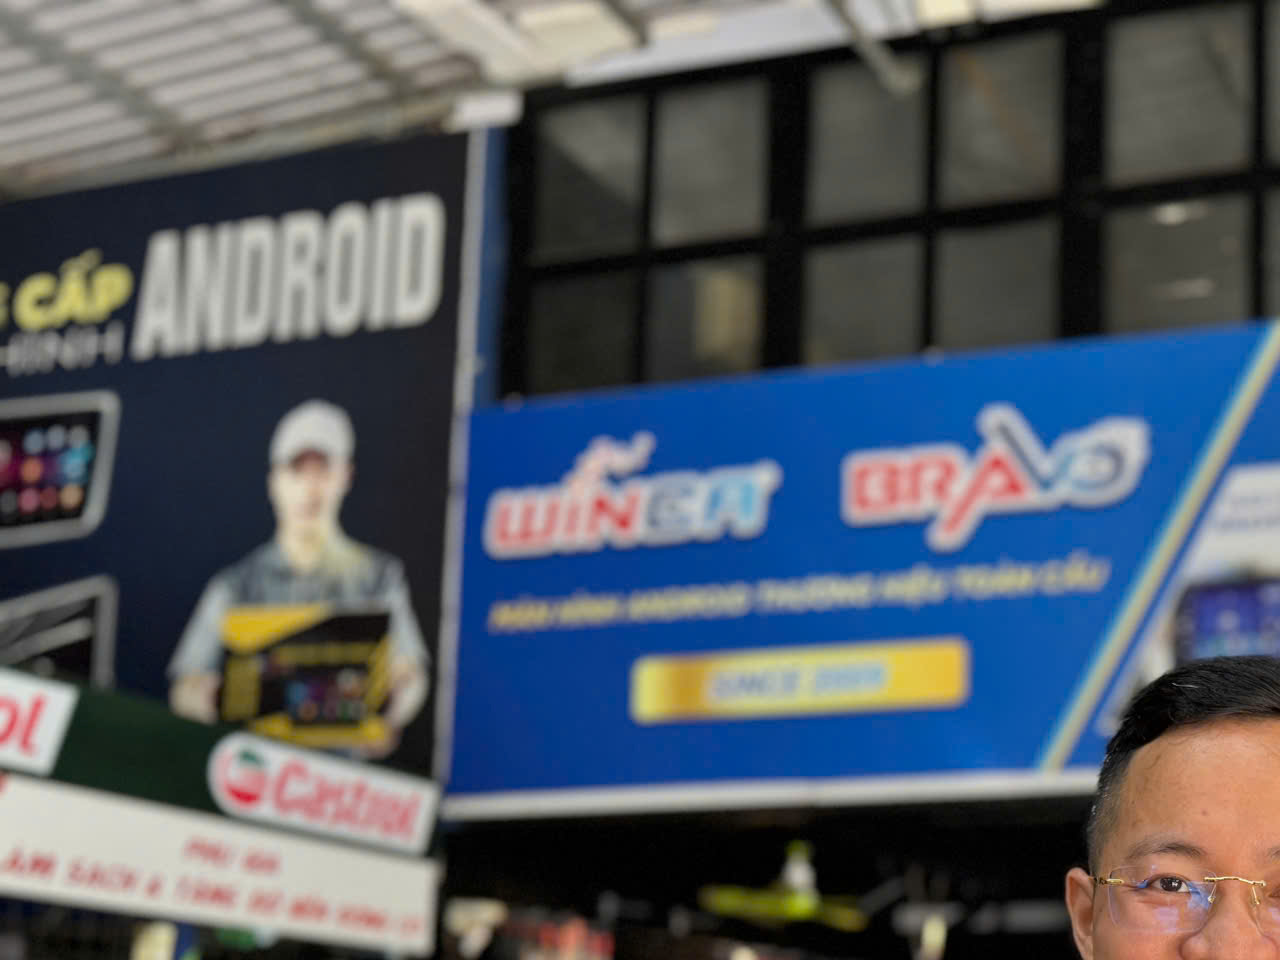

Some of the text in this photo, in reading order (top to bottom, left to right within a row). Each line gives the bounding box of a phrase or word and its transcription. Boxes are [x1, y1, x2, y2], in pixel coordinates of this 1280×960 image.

[12, 246, 135, 331] CẤP
[131, 192, 446, 361] ANDROID
[842, 403, 1150, 551] BRAVO
[271, 757, 424, 842] Castrol
